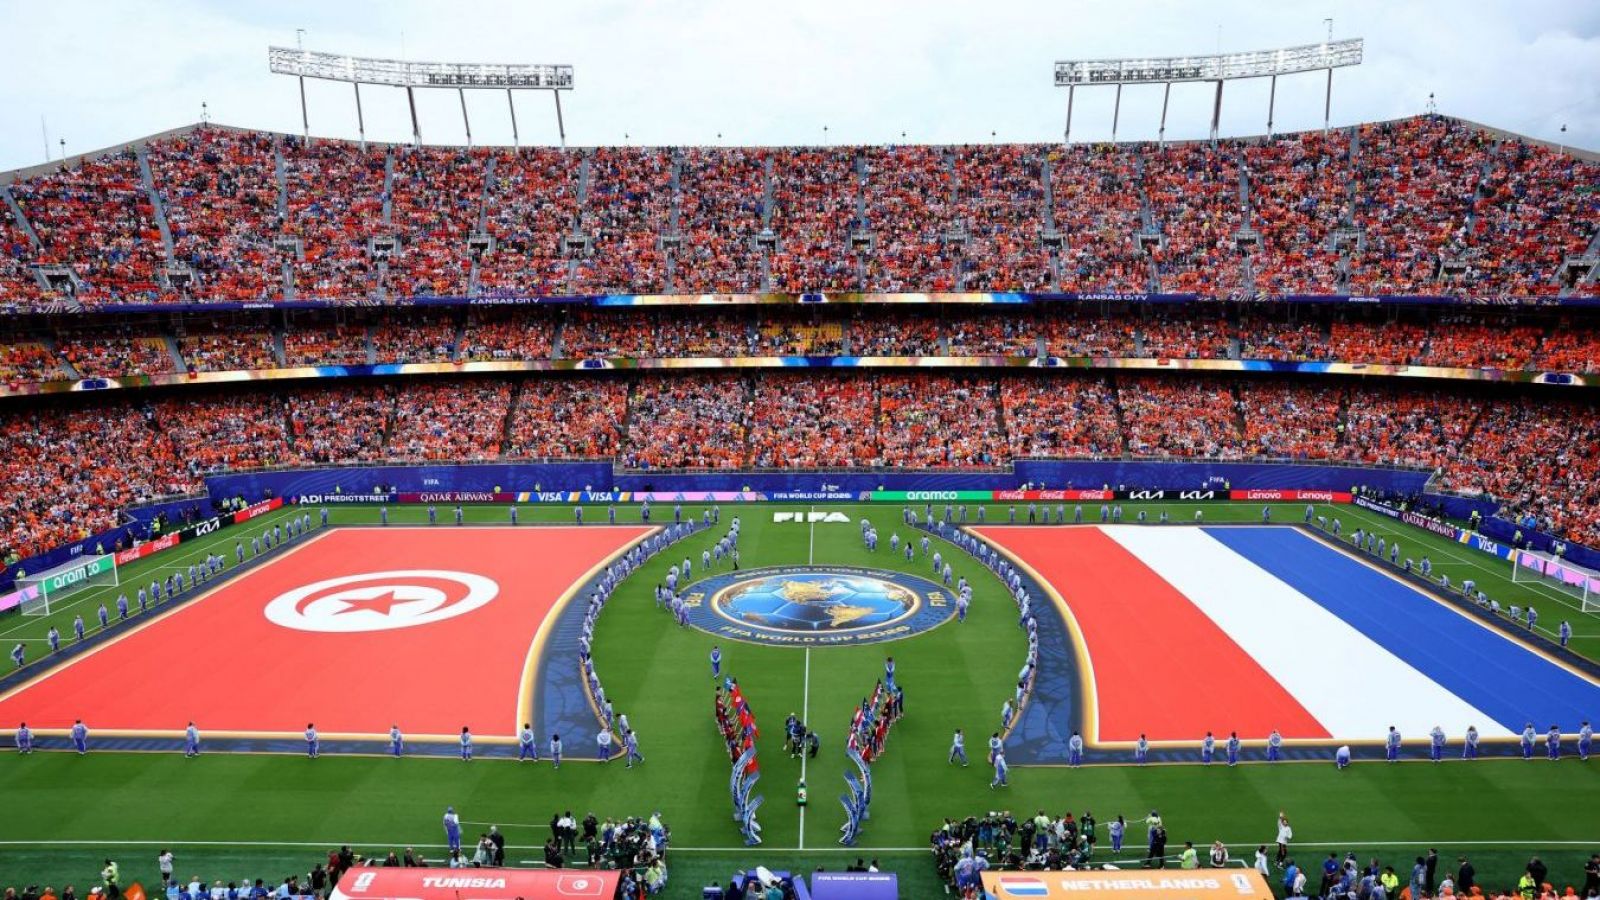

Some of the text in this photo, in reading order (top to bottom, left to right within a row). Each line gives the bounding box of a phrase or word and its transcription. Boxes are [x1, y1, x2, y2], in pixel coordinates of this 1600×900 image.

[424, 478, 439, 486] FIFA
[1209, 476, 1224, 484] FIFA
[300, 495, 322, 504] ADI
[420, 493, 493, 502] QATAR AIRWAYS
[537, 493, 562, 501] VISA
[588, 493, 613, 501] VISA
[906, 491, 958, 500] aramco
[1247, 491, 1281, 499] Lenovo
[1297, 491, 1332, 500] Lenovo
[249, 504, 270, 518] Lenovo
[773, 511, 851, 523] FIFA
[1402, 513, 1454, 538] QATAR AIRWAYS
[1478, 538, 1498, 555] VISA
[721, 626, 752, 637] FIFA
[755, 632, 815, 643] WORLD
[423, 877, 506, 888] TUNISIA
[1062, 876, 1220, 890] NETHERLANDS
